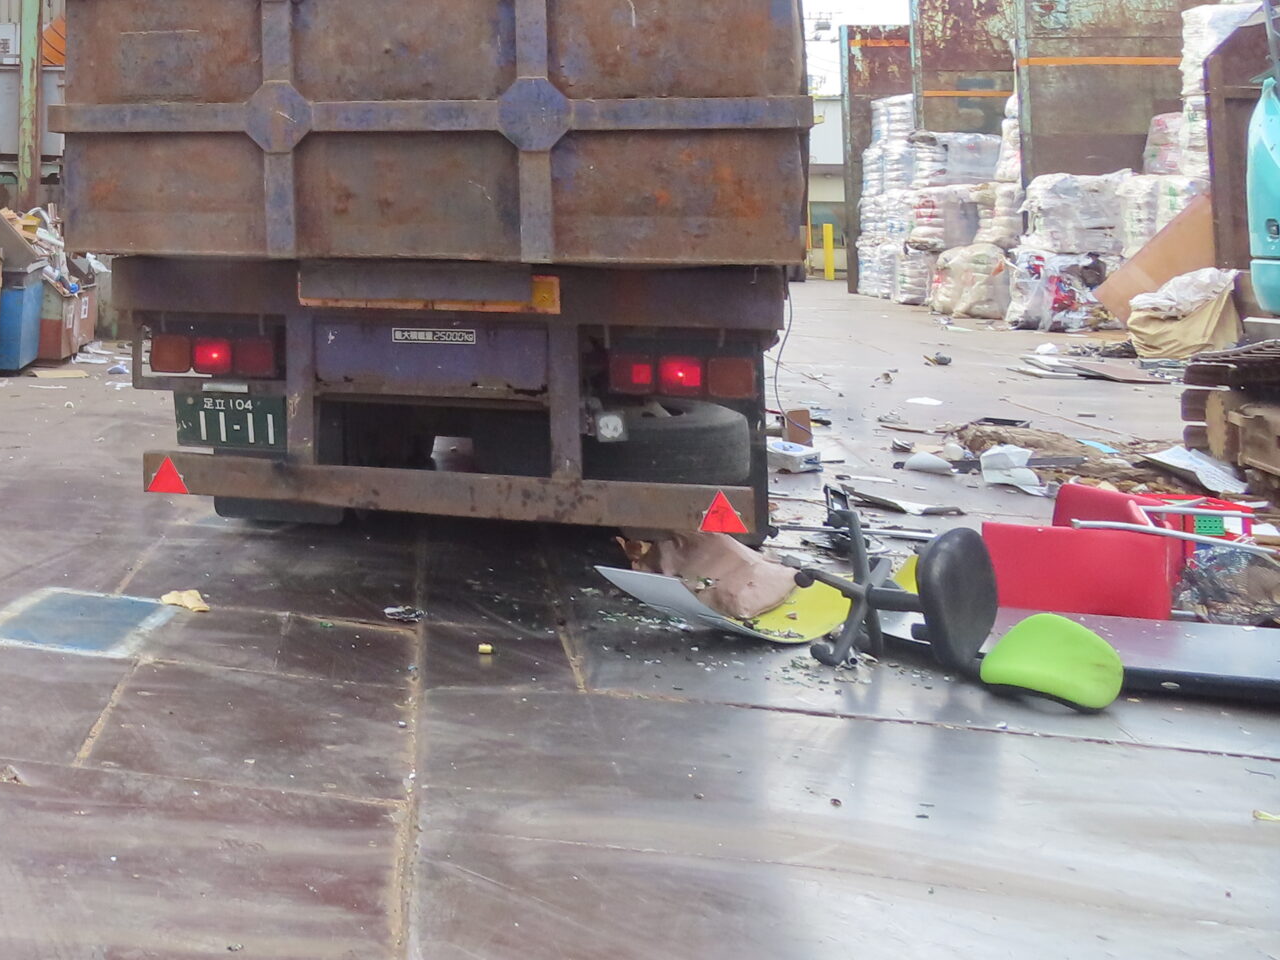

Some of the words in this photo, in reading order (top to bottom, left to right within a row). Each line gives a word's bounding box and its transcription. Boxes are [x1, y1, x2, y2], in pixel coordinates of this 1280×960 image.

[203, 397, 226, 410] 足立
[229, 399, 253, 411] 104
[199, 410, 275, 445] 11-11
